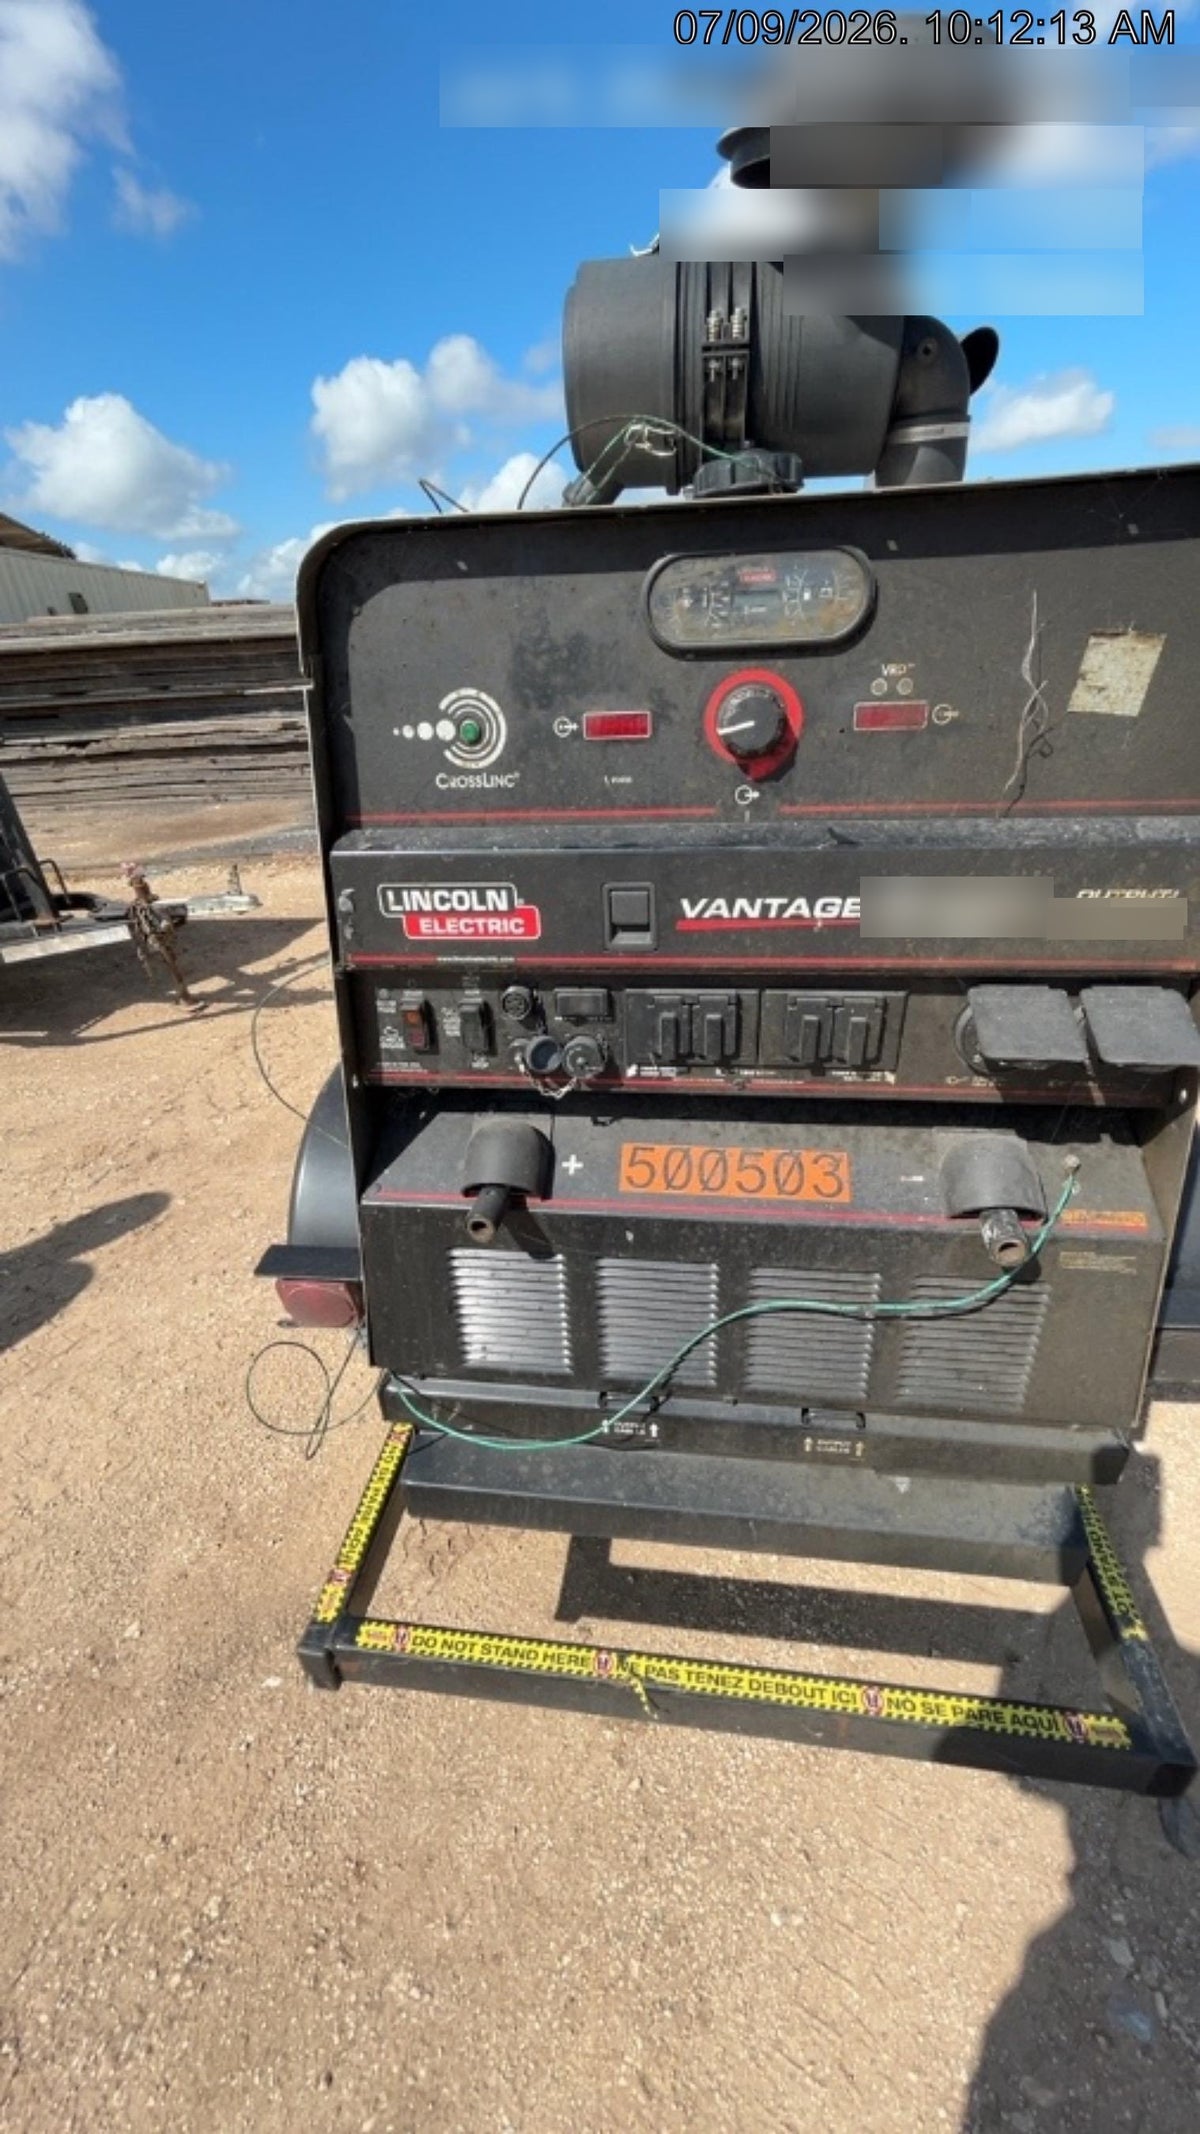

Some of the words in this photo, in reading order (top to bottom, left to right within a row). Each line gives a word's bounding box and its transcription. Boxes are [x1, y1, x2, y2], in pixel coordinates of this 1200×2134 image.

[386, 890, 508, 911] LINCOLN
[680, 897, 860, 918] VANTAGE
[419, 917, 525, 935] ELECTRIC
[625, 1146, 845, 1199] 500503
[412, 1635, 437, 1649] DO
[440, 1638, 476, 1653] NOT
[481, 1642, 539, 1661] STAND
[542, 1650, 592, 1668] HERE
[644, 1662, 680, 1681] PAS
[686, 1667, 744, 1688] TENEZ
[748, 1679, 827, 1700] DEBOUT
[831, 1690, 857, 1705] ICI
[886, 1697, 917, 1712] NO
[921, 1701, 947, 1717] SE
[952, 1706, 1005, 1725] PARE
